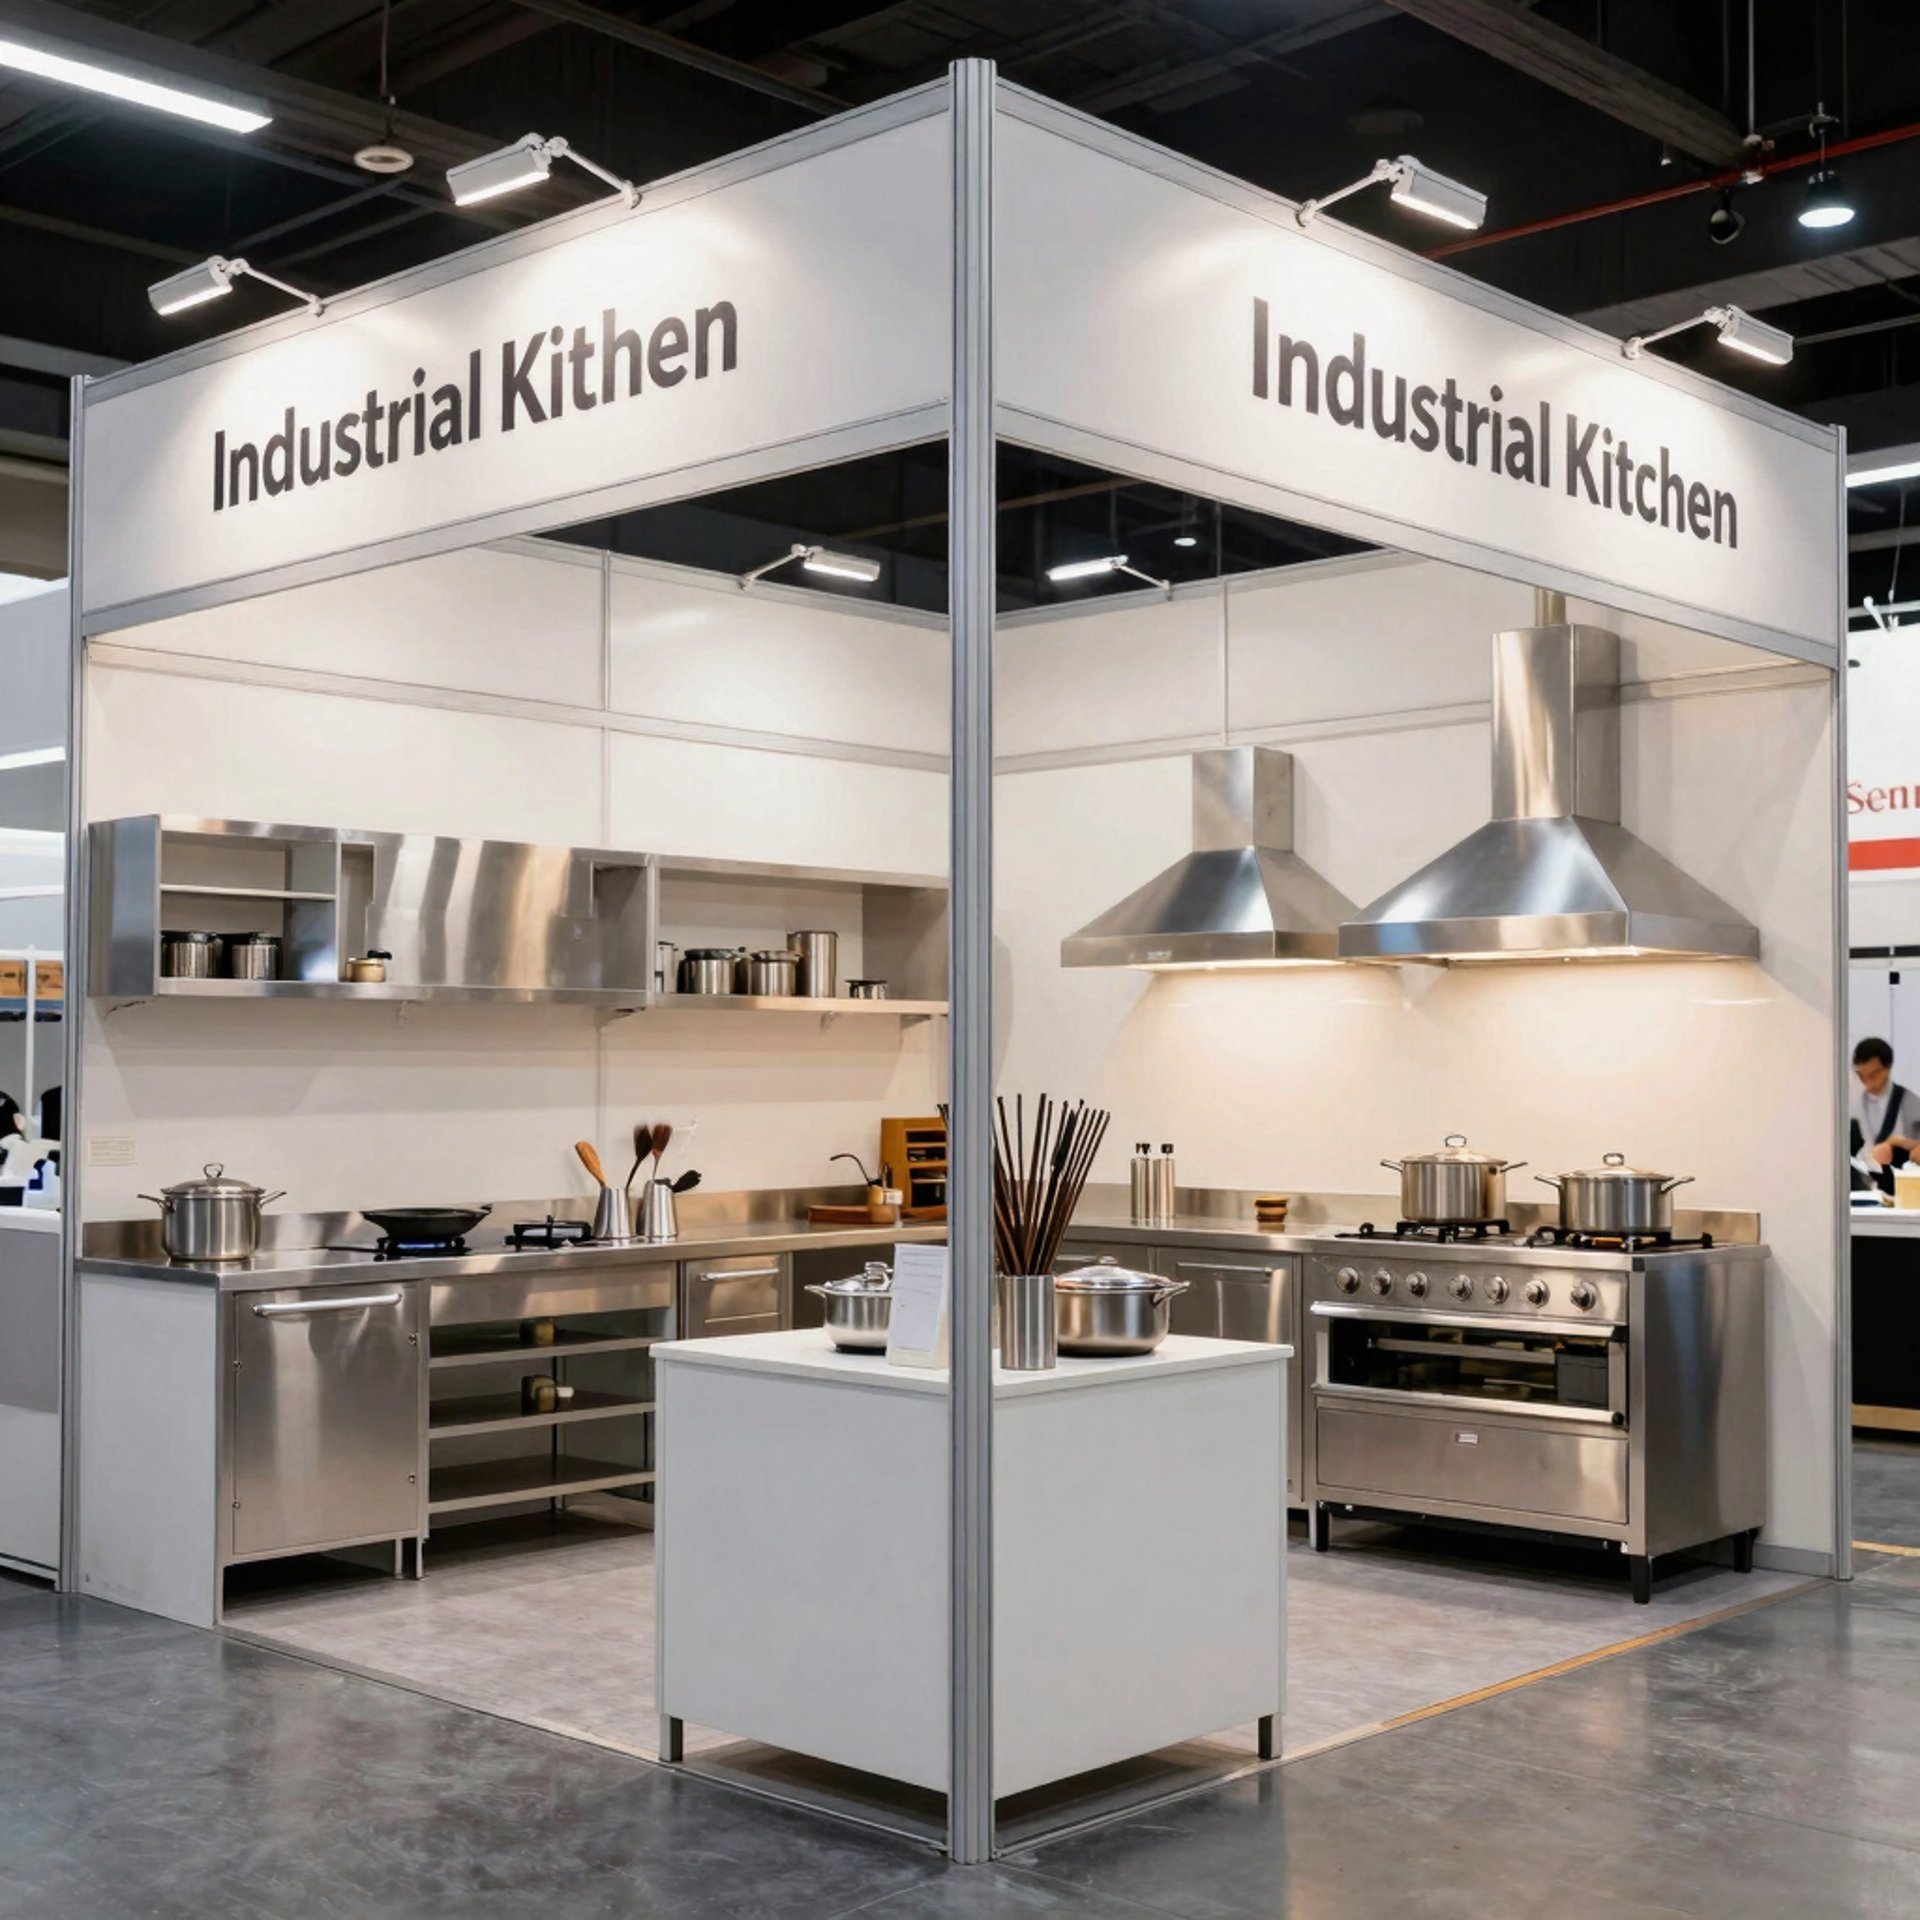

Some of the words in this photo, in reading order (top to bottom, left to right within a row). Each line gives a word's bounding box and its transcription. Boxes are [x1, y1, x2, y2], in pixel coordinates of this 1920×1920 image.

[212, 348, 482, 512] Industrial
[501, 300, 739, 433] Kithen
[1252, 297, 1551, 488] Industrial
[1566, 413, 1739, 549] Kitchen
